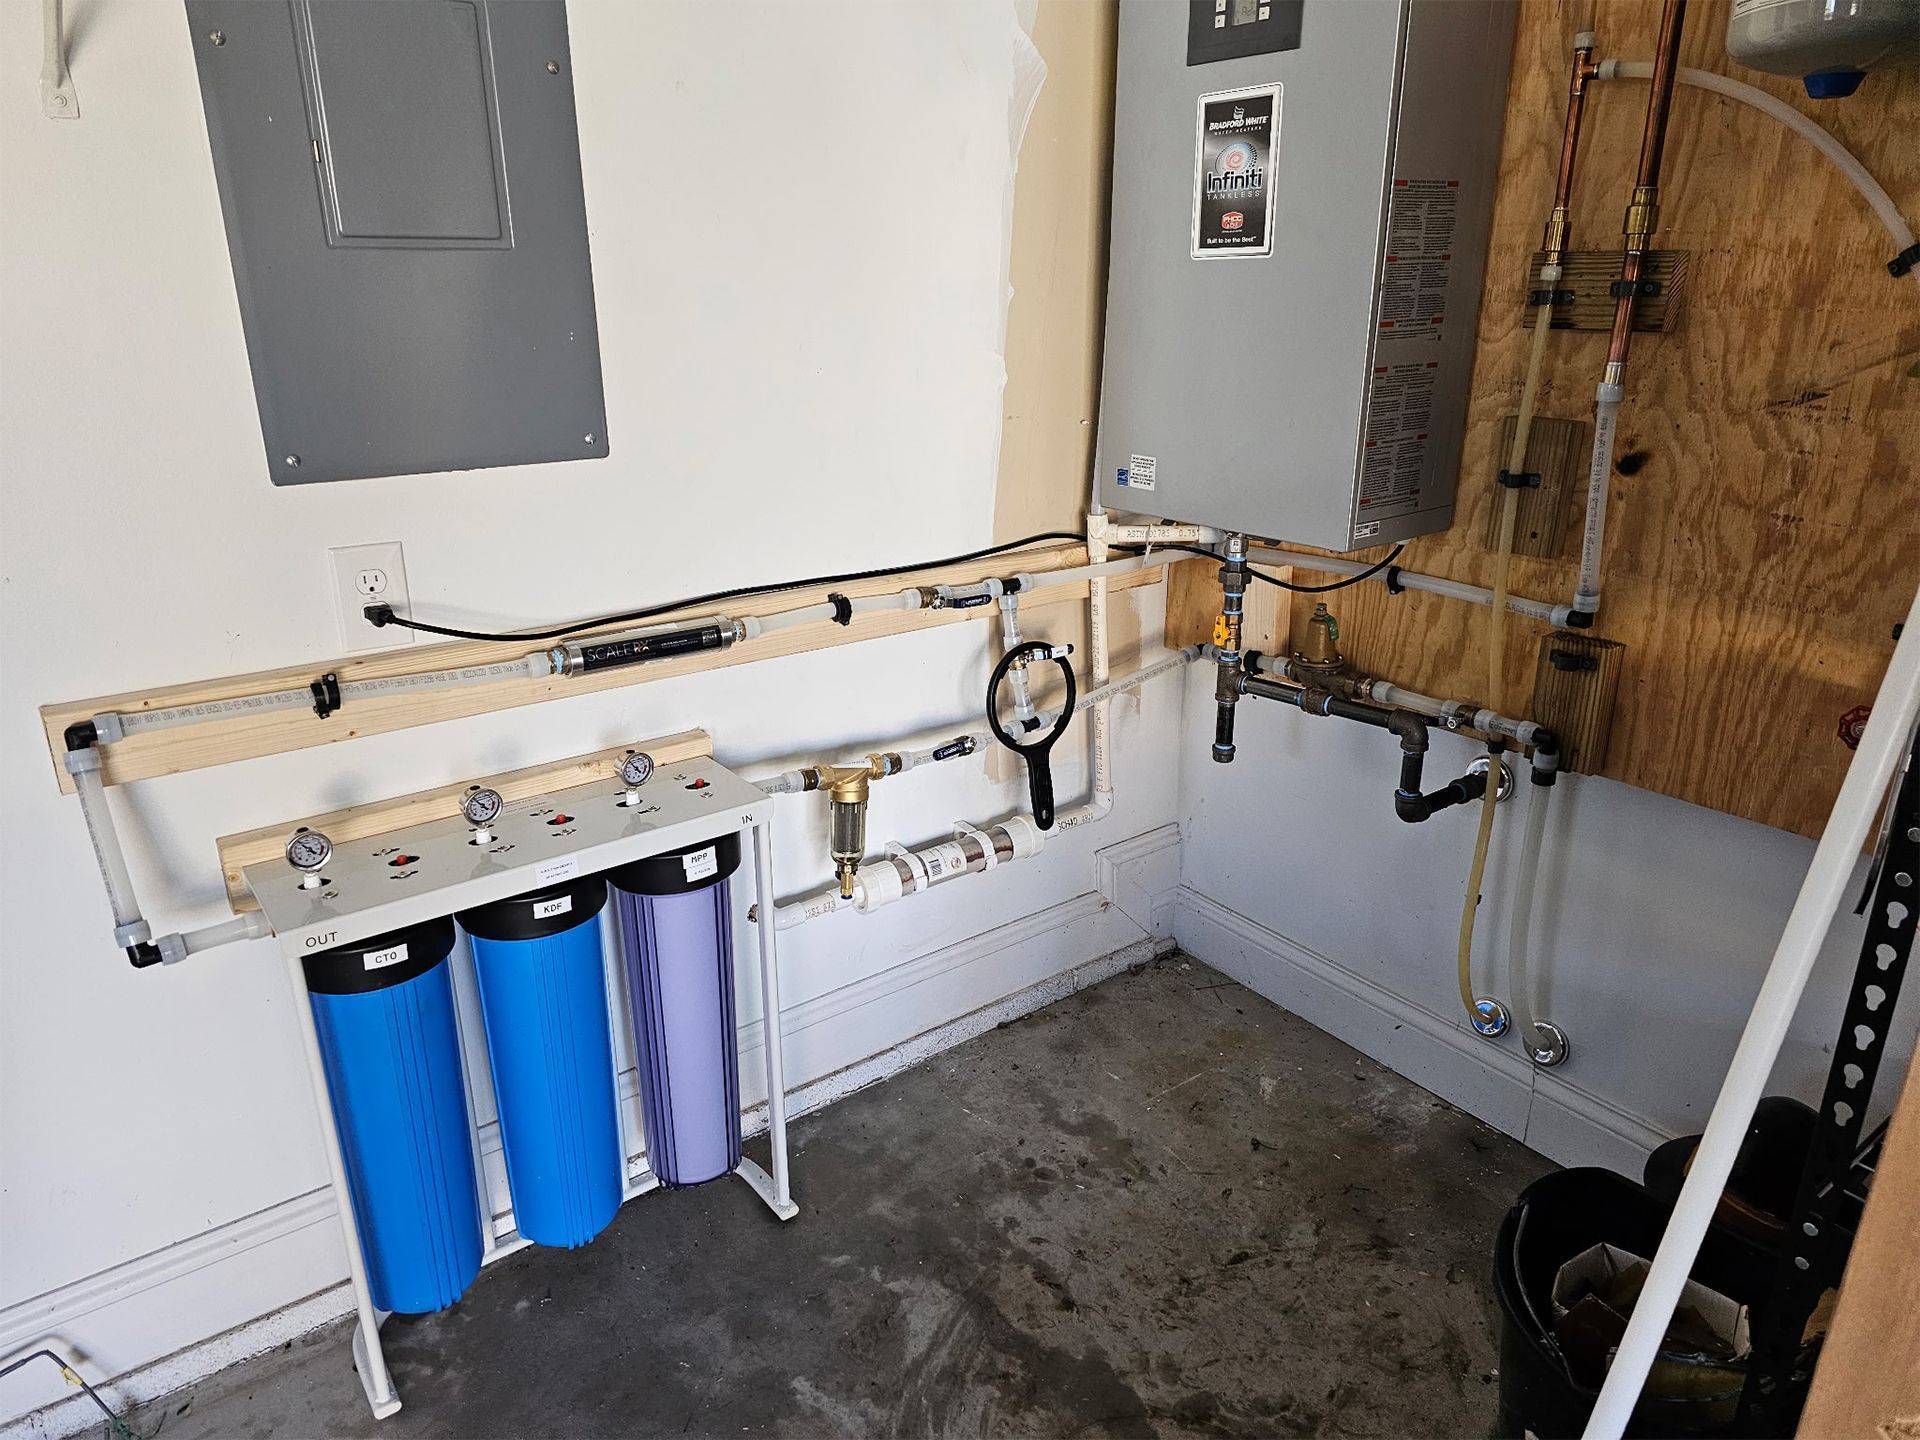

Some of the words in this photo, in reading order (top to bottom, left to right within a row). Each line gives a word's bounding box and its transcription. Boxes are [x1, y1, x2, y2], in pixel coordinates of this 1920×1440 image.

[1208, 119, 1245, 131] BRADFORD
[1245, 116, 1269, 126] WHITE
[1207, 167, 1263, 193] Infiniti
[1206, 189, 1261, 200] TANKLESS
[741, 813, 754, 825] IN
[691, 852, 708, 864] MPP
[543, 902, 563, 914] KDF
[305, 931, 338, 948] OUT
[375, 951, 398, 964] CTO
